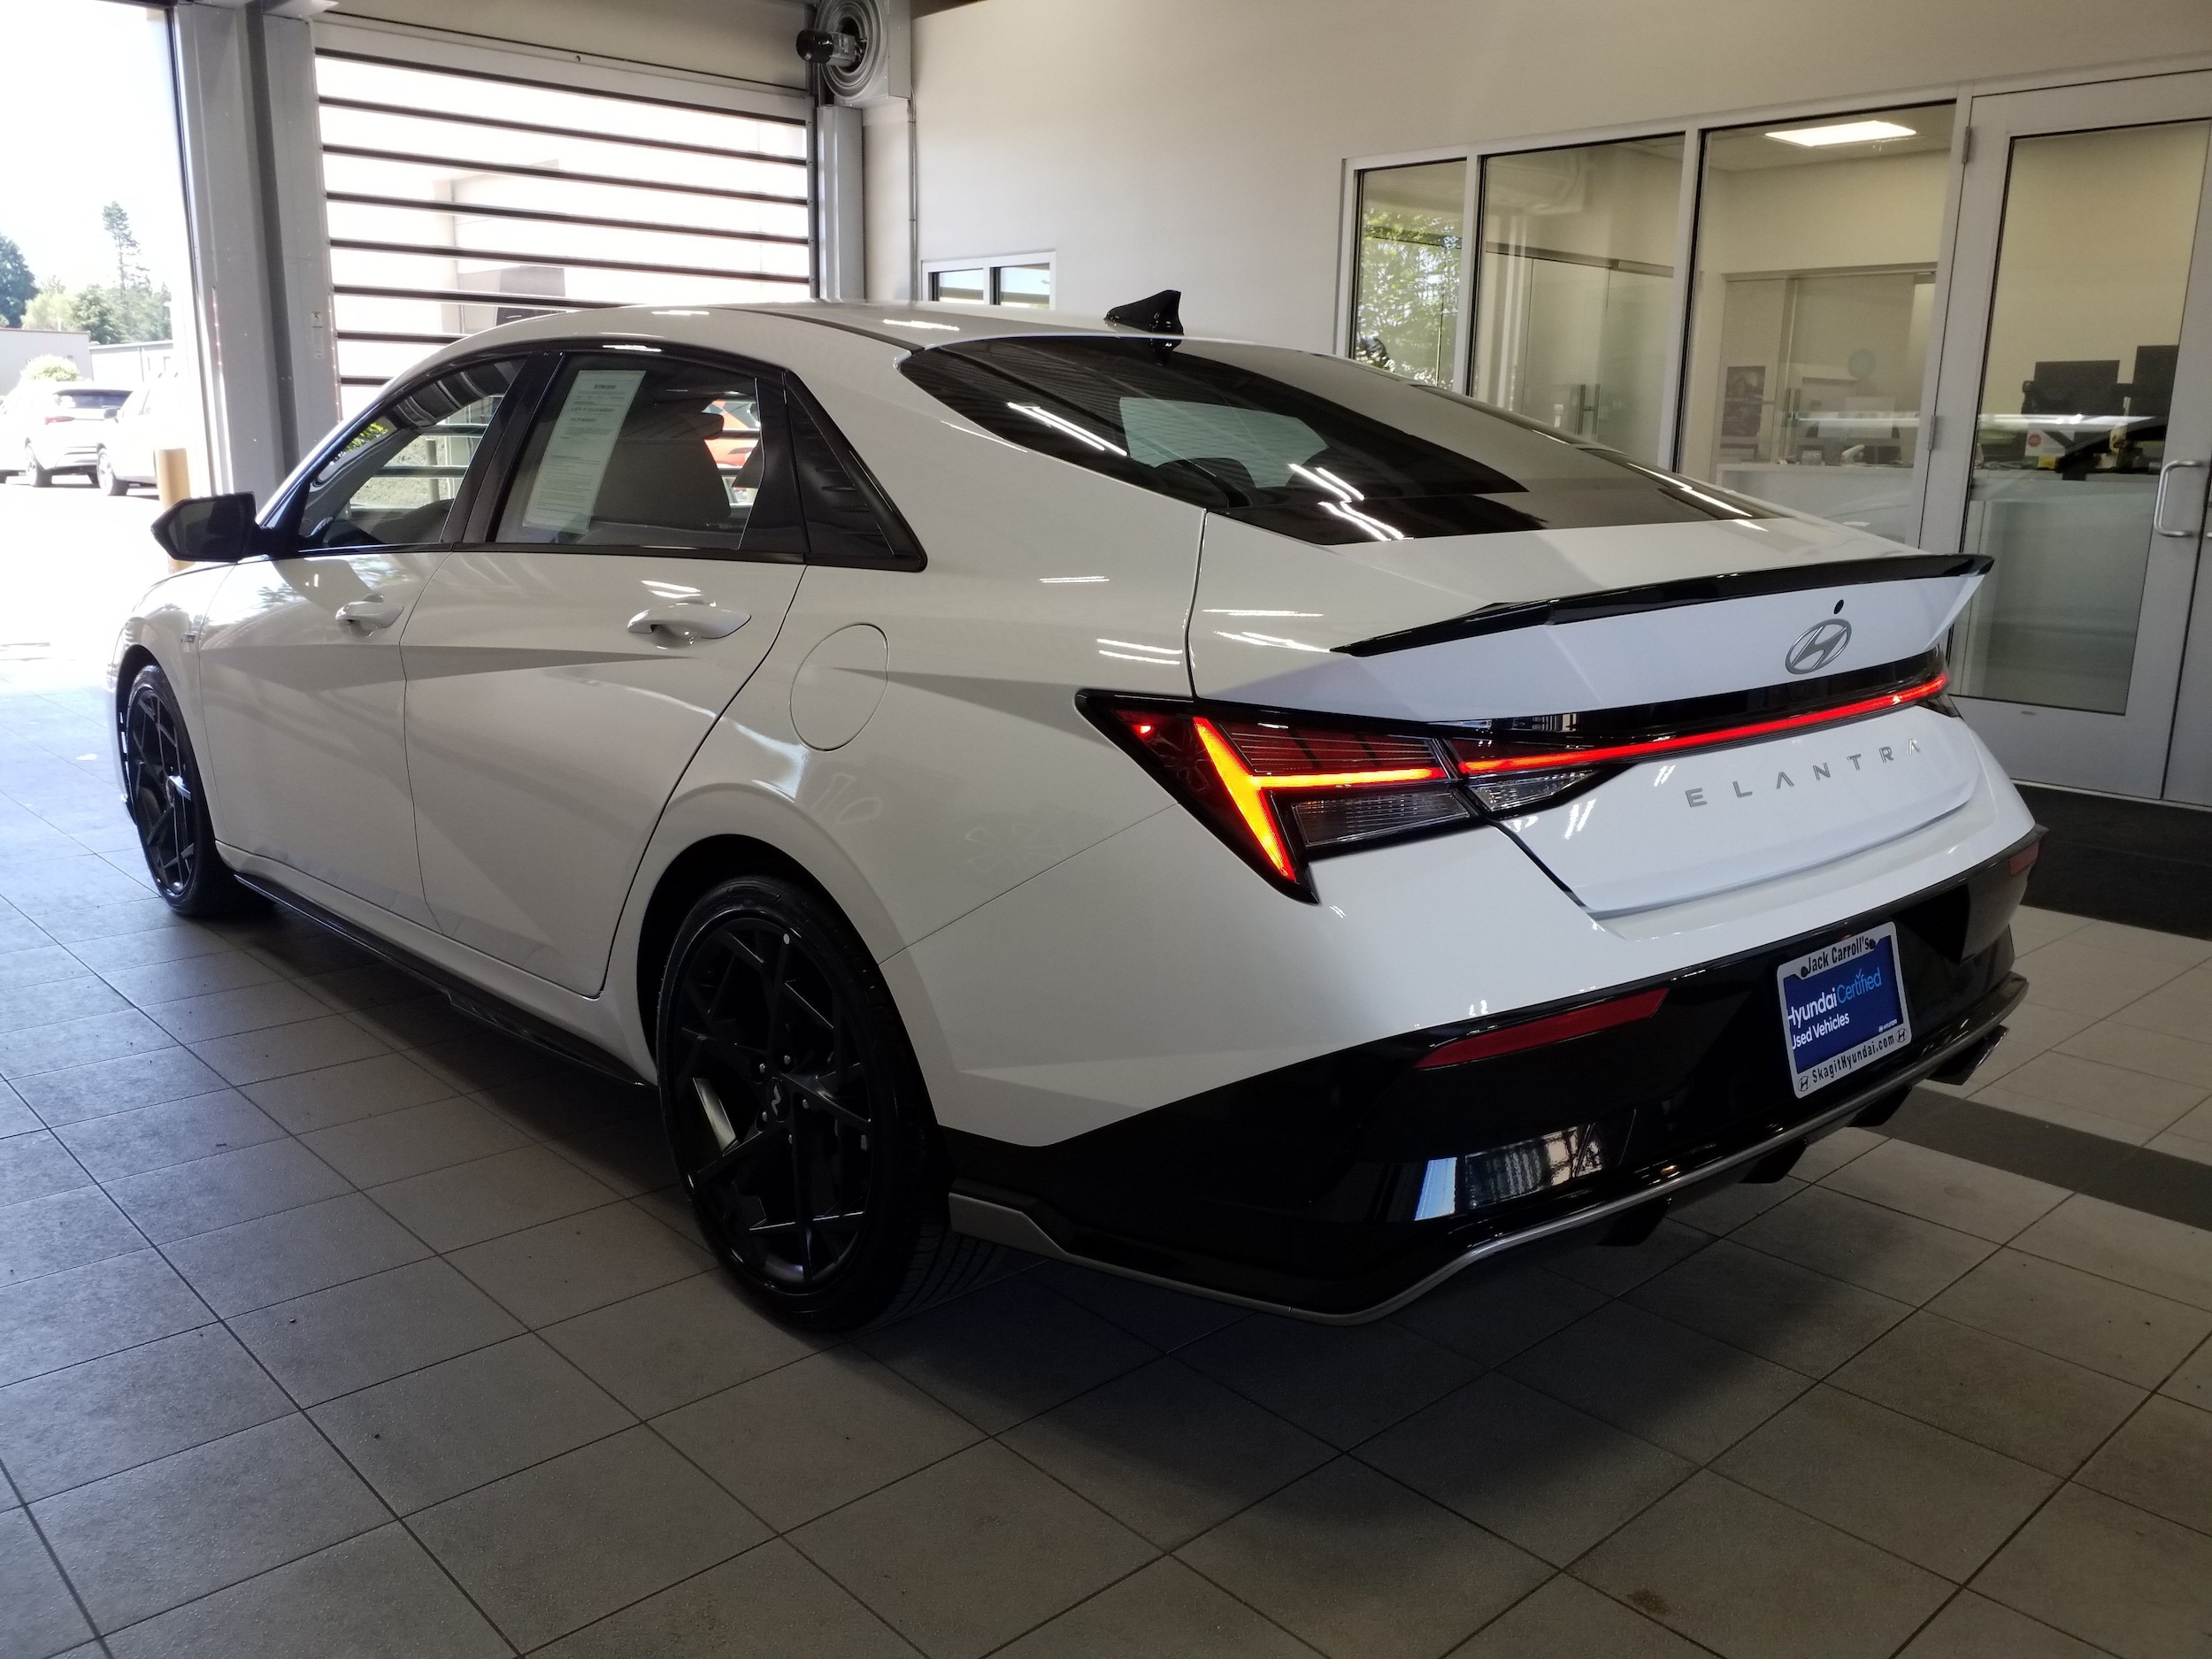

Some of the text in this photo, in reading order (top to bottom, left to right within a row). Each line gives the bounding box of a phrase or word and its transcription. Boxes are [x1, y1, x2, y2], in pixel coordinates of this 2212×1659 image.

[1685, 738, 1921, 807] ELANTRA
[1808, 935, 1869, 974] Jack Carroll's
[1812, 1012, 1850, 1039] Vehicles
[1812, 1034, 1895, 1083] SkagitHyundai.com
